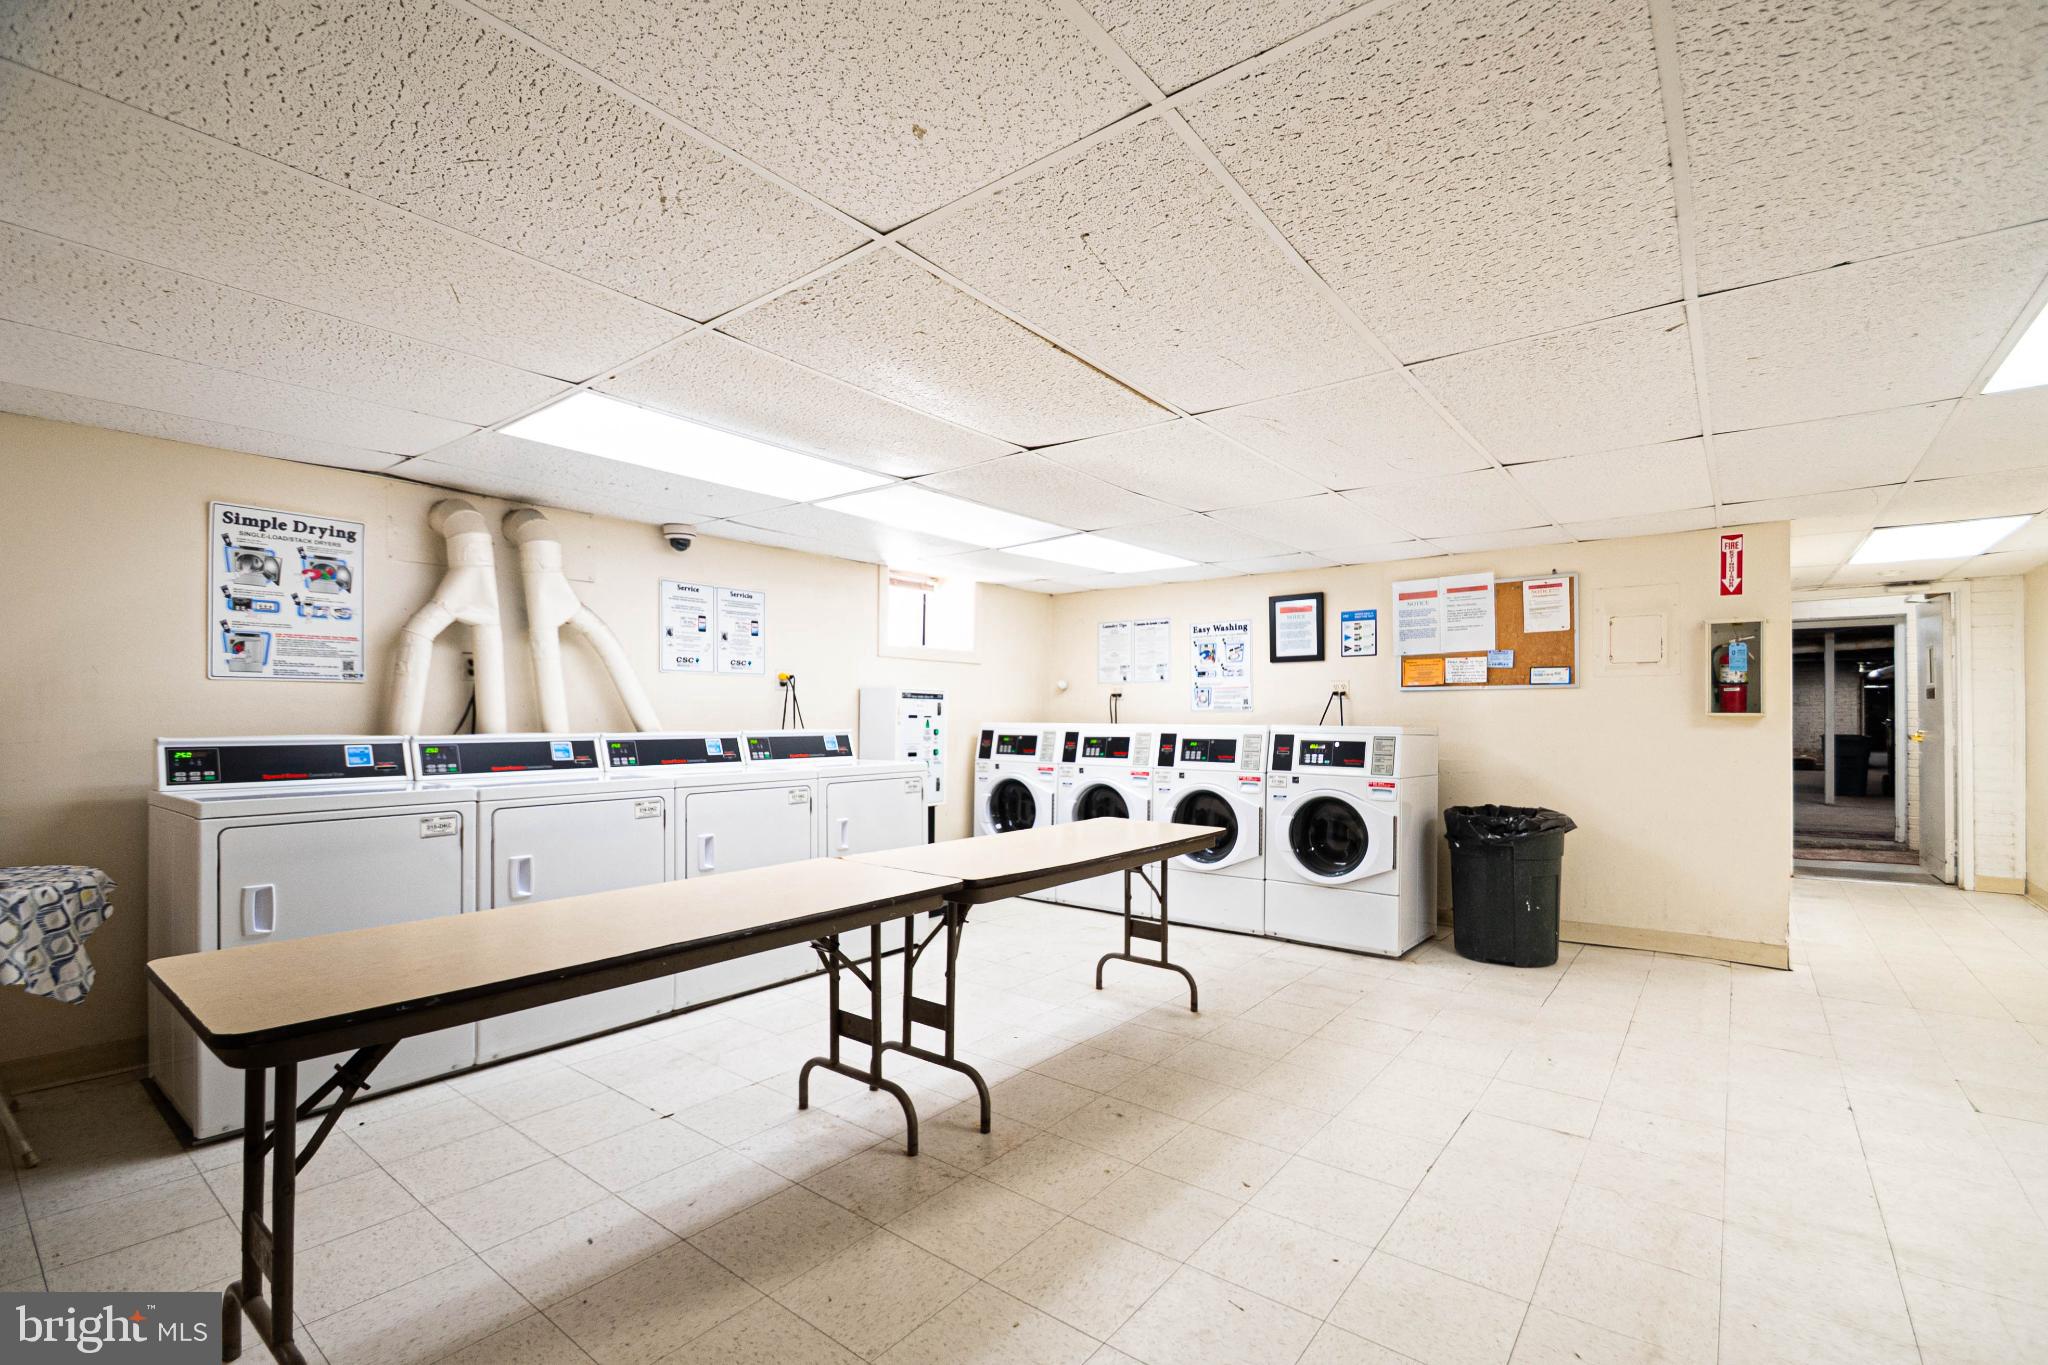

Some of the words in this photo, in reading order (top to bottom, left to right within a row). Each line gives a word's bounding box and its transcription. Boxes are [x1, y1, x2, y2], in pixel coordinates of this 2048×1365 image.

[222, 510, 288, 533] Simple
[292, 520, 358, 543] Drying
[1724, 541, 1740, 550] FIRE
[677, 584, 700, 594] Service
[730, 591, 753, 600] Servicio
[1193, 626, 1211, 635] Easy
[1212, 623, 1248, 633] Washing
[676, 656, 695, 664] CSC
[730, 659, 747, 667] CSC
